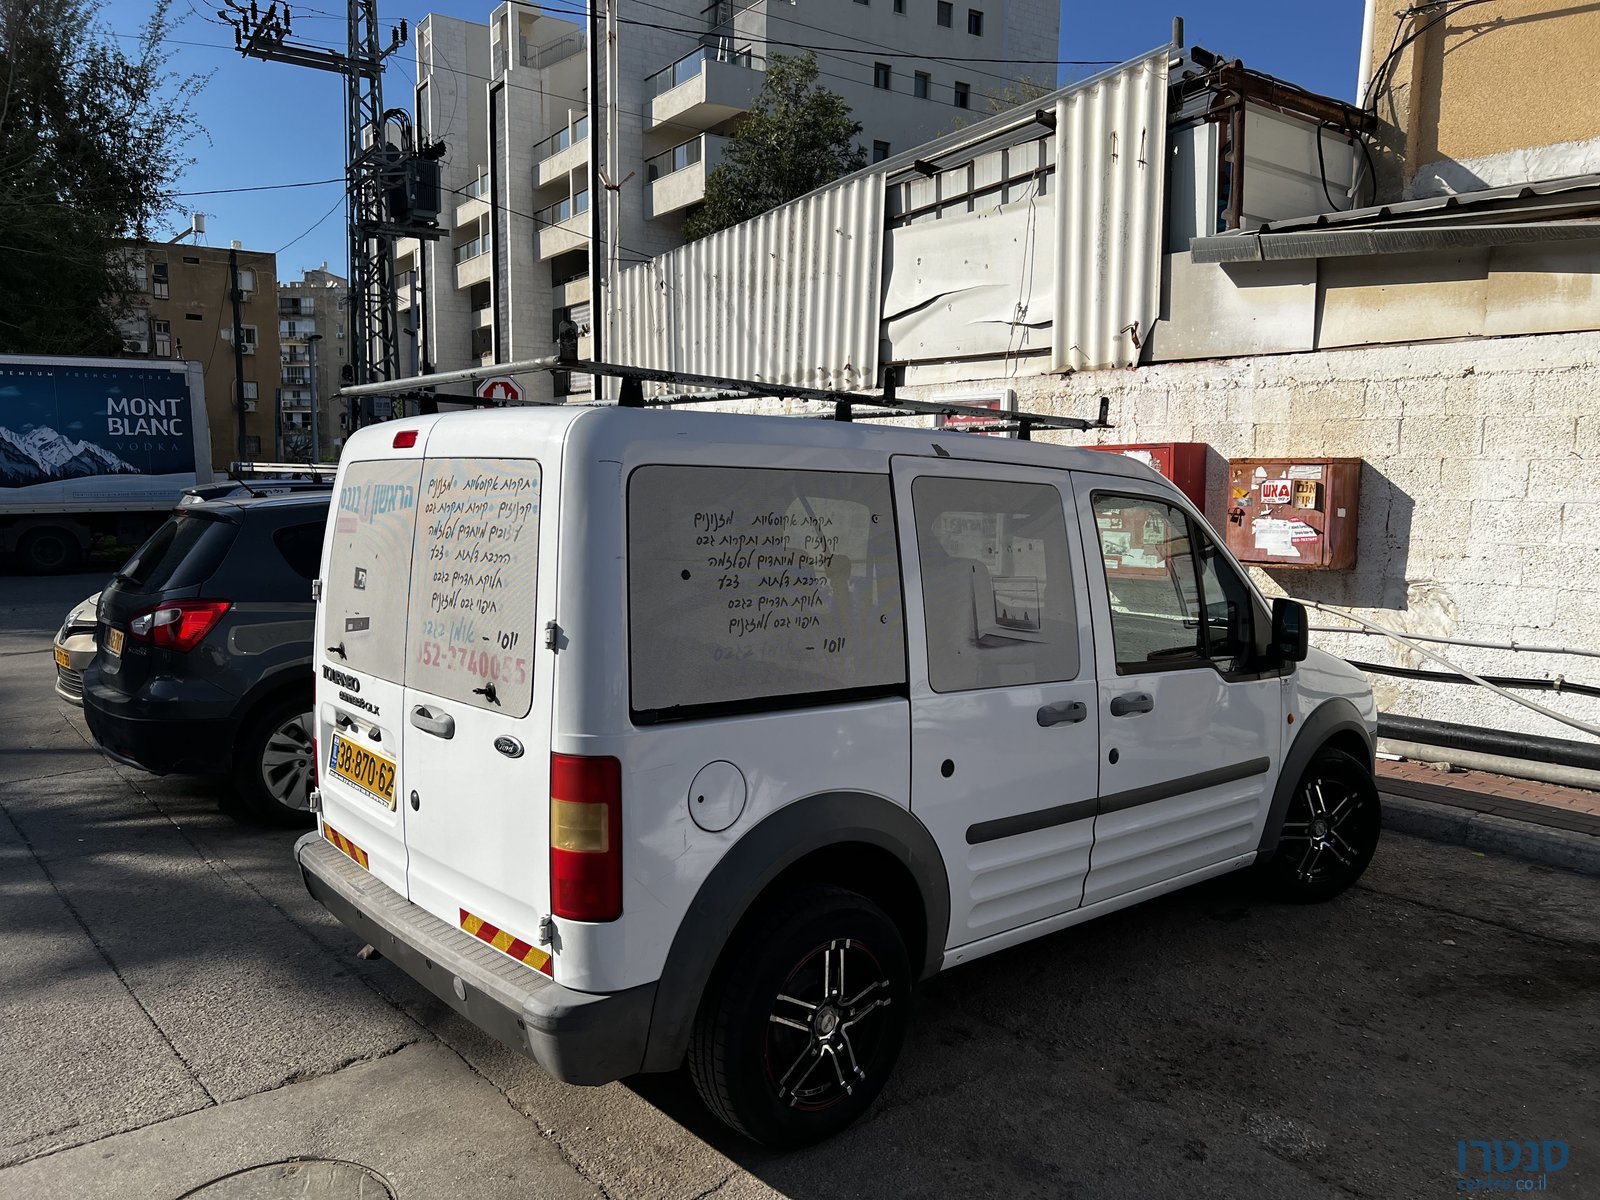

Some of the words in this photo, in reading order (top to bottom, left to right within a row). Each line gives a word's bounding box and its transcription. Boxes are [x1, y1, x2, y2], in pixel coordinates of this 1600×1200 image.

[107, 398, 181, 416] MONT
[108, 417, 183, 436] BLANC
[116, 442, 179, 451] VODKA
[500, 478, 530, 497] תקרות
[1263, 484, 1278, 497] אש
[425, 502, 436, 514] גבס
[752, 512, 798, 531] אקוסטיות
[801, 516, 833, 531] תקרות
[696, 536, 715, 547] גבס
[719, 535, 758, 551] ותקרות
[761, 535, 790, 551] קירות
[757, 552, 794, 570] מיוחדים
[434, 572, 449, 583] בגבס
[718, 574, 739, 589] צבע
[758, 569, 789, 588] דלתות
[793, 576, 828, 587] הרכבת
[461, 598, 473, 610] גבס
[728, 600, 752, 609] בגבס
[758, 596, 788, 611] חדרים
[791, 589, 822, 611] חלוקת
[774, 618, 791, 628] גבס
[795, 616, 820, 629] חיפוי
[496, 630, 519, 650] יוסי
[823, 637, 845, 653] יוסי
